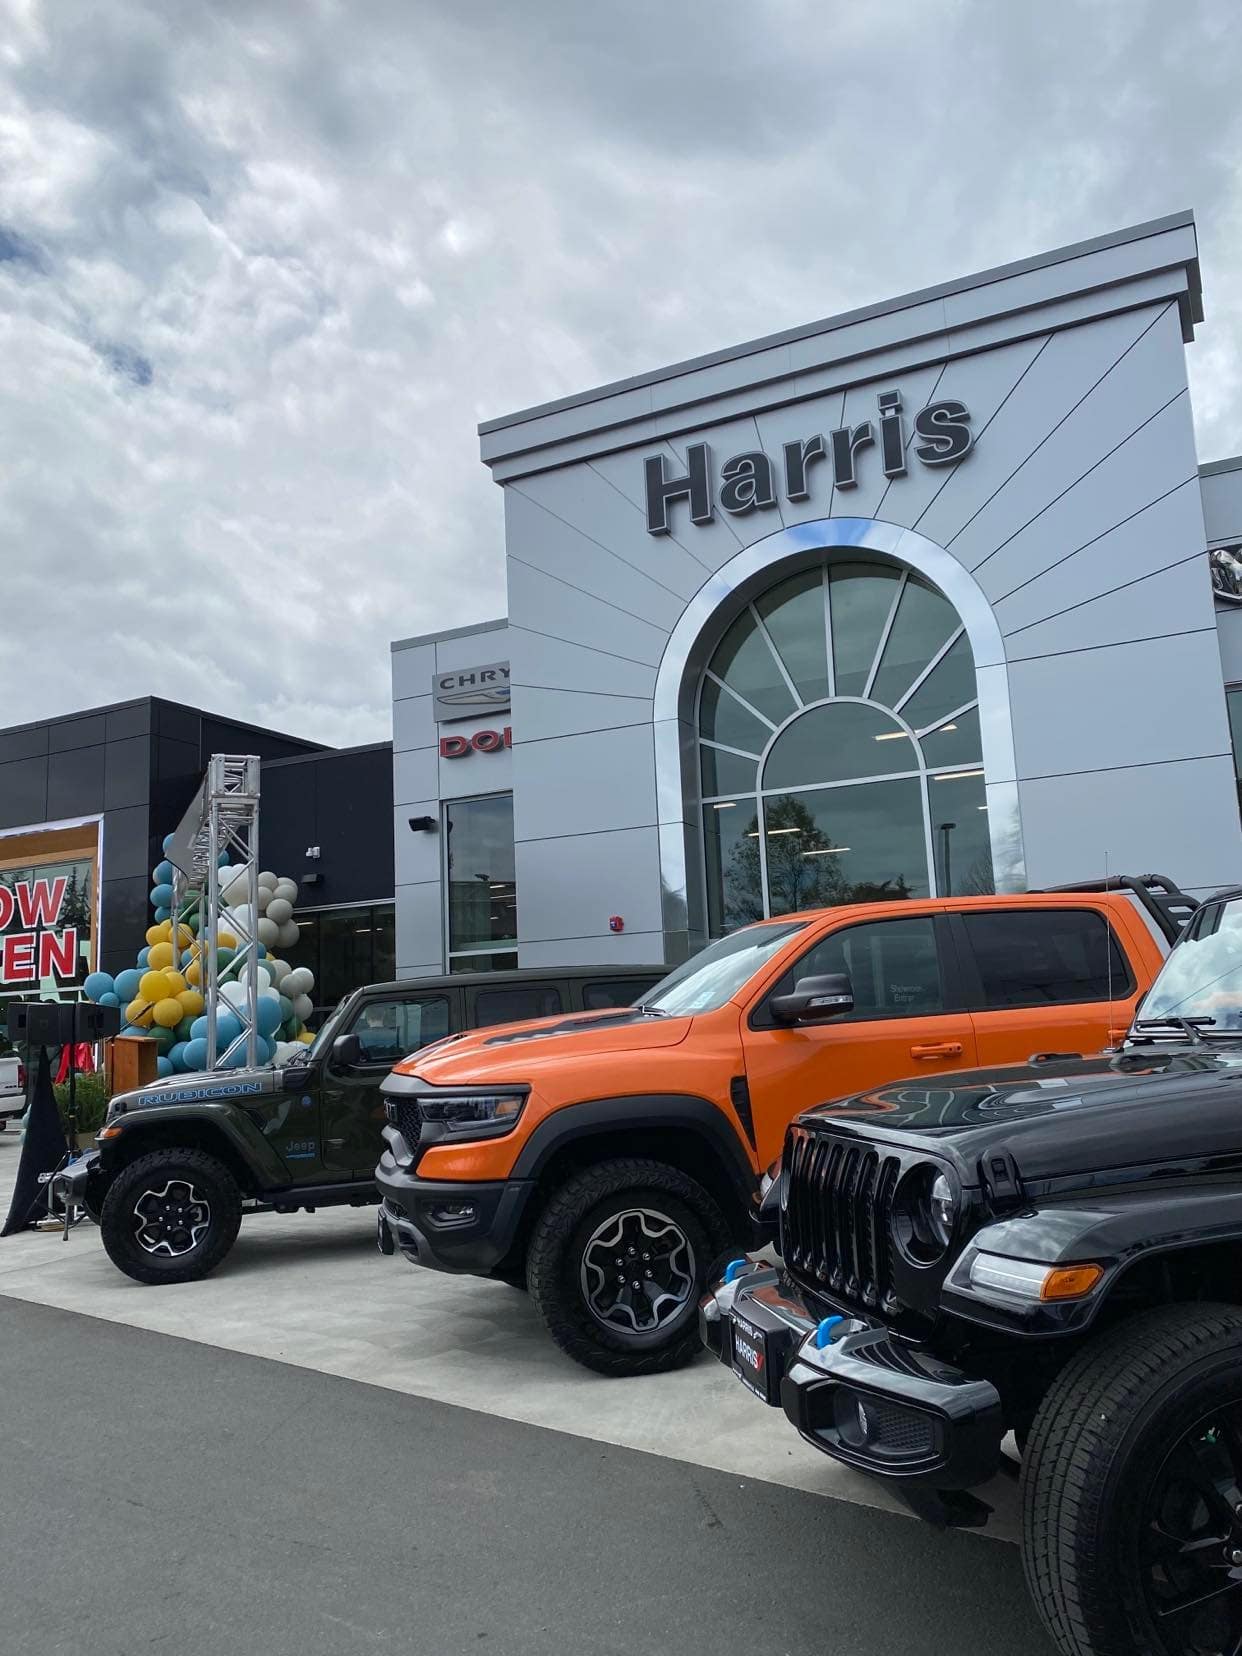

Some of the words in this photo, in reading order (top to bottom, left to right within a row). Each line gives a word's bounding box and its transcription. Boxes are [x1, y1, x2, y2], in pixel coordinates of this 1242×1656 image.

[644, 389, 974, 536] Harris
[3, 928, 77, 982] EN
[138, 1083, 262, 1105] RUBICON
[286, 1141, 316, 1152] Jeep
[735, 1333, 759, 1369] HARRIS
